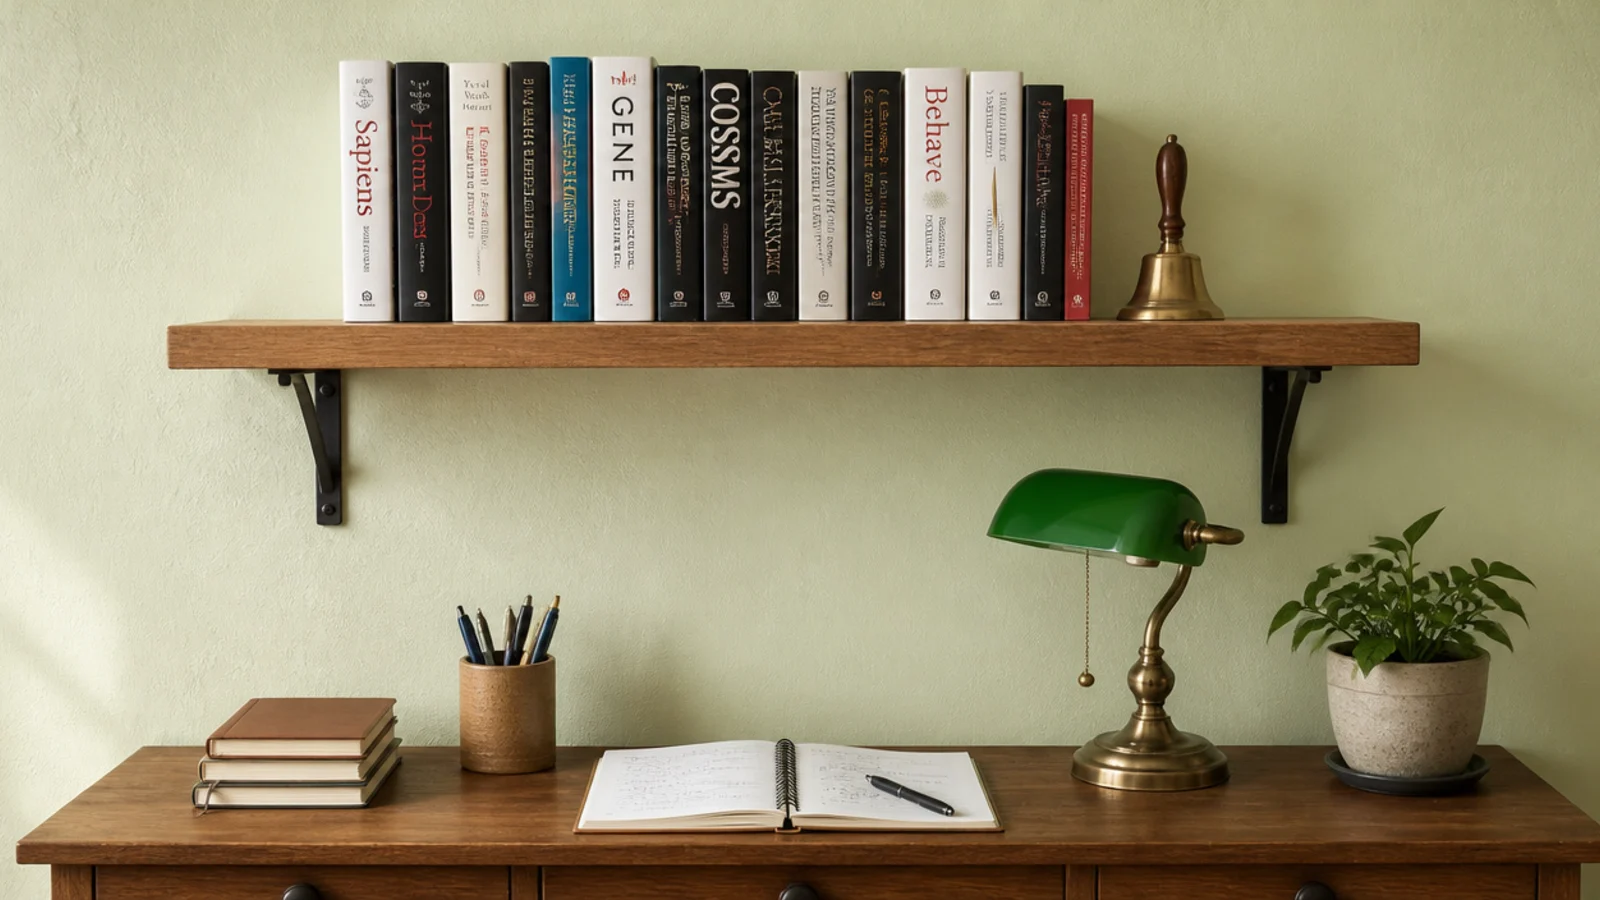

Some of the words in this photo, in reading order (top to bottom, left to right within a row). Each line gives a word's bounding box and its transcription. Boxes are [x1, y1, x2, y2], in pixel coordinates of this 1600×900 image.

[349, 120, 379, 216] Sapiens
[611, 96, 634, 182] GENE
[924, 86, 951, 183] Behave
